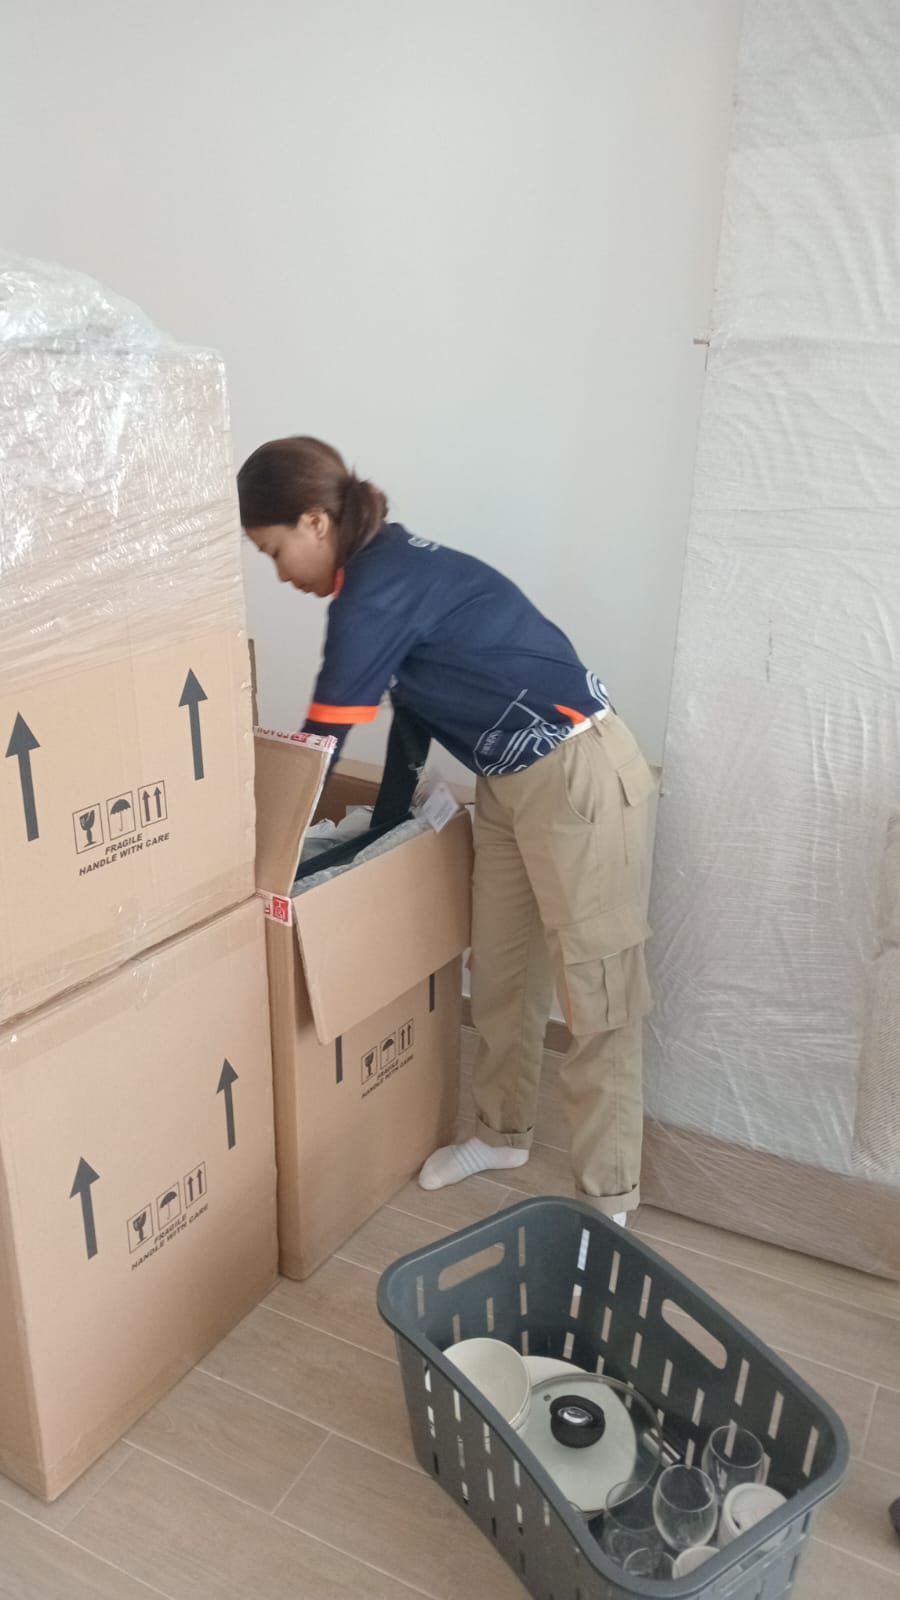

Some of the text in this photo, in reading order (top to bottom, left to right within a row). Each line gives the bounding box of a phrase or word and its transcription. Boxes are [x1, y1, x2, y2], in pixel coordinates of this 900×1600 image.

[79, 832, 170, 876] HANDLE WITH CARE
[105, 833, 142, 855] FRAGILE
